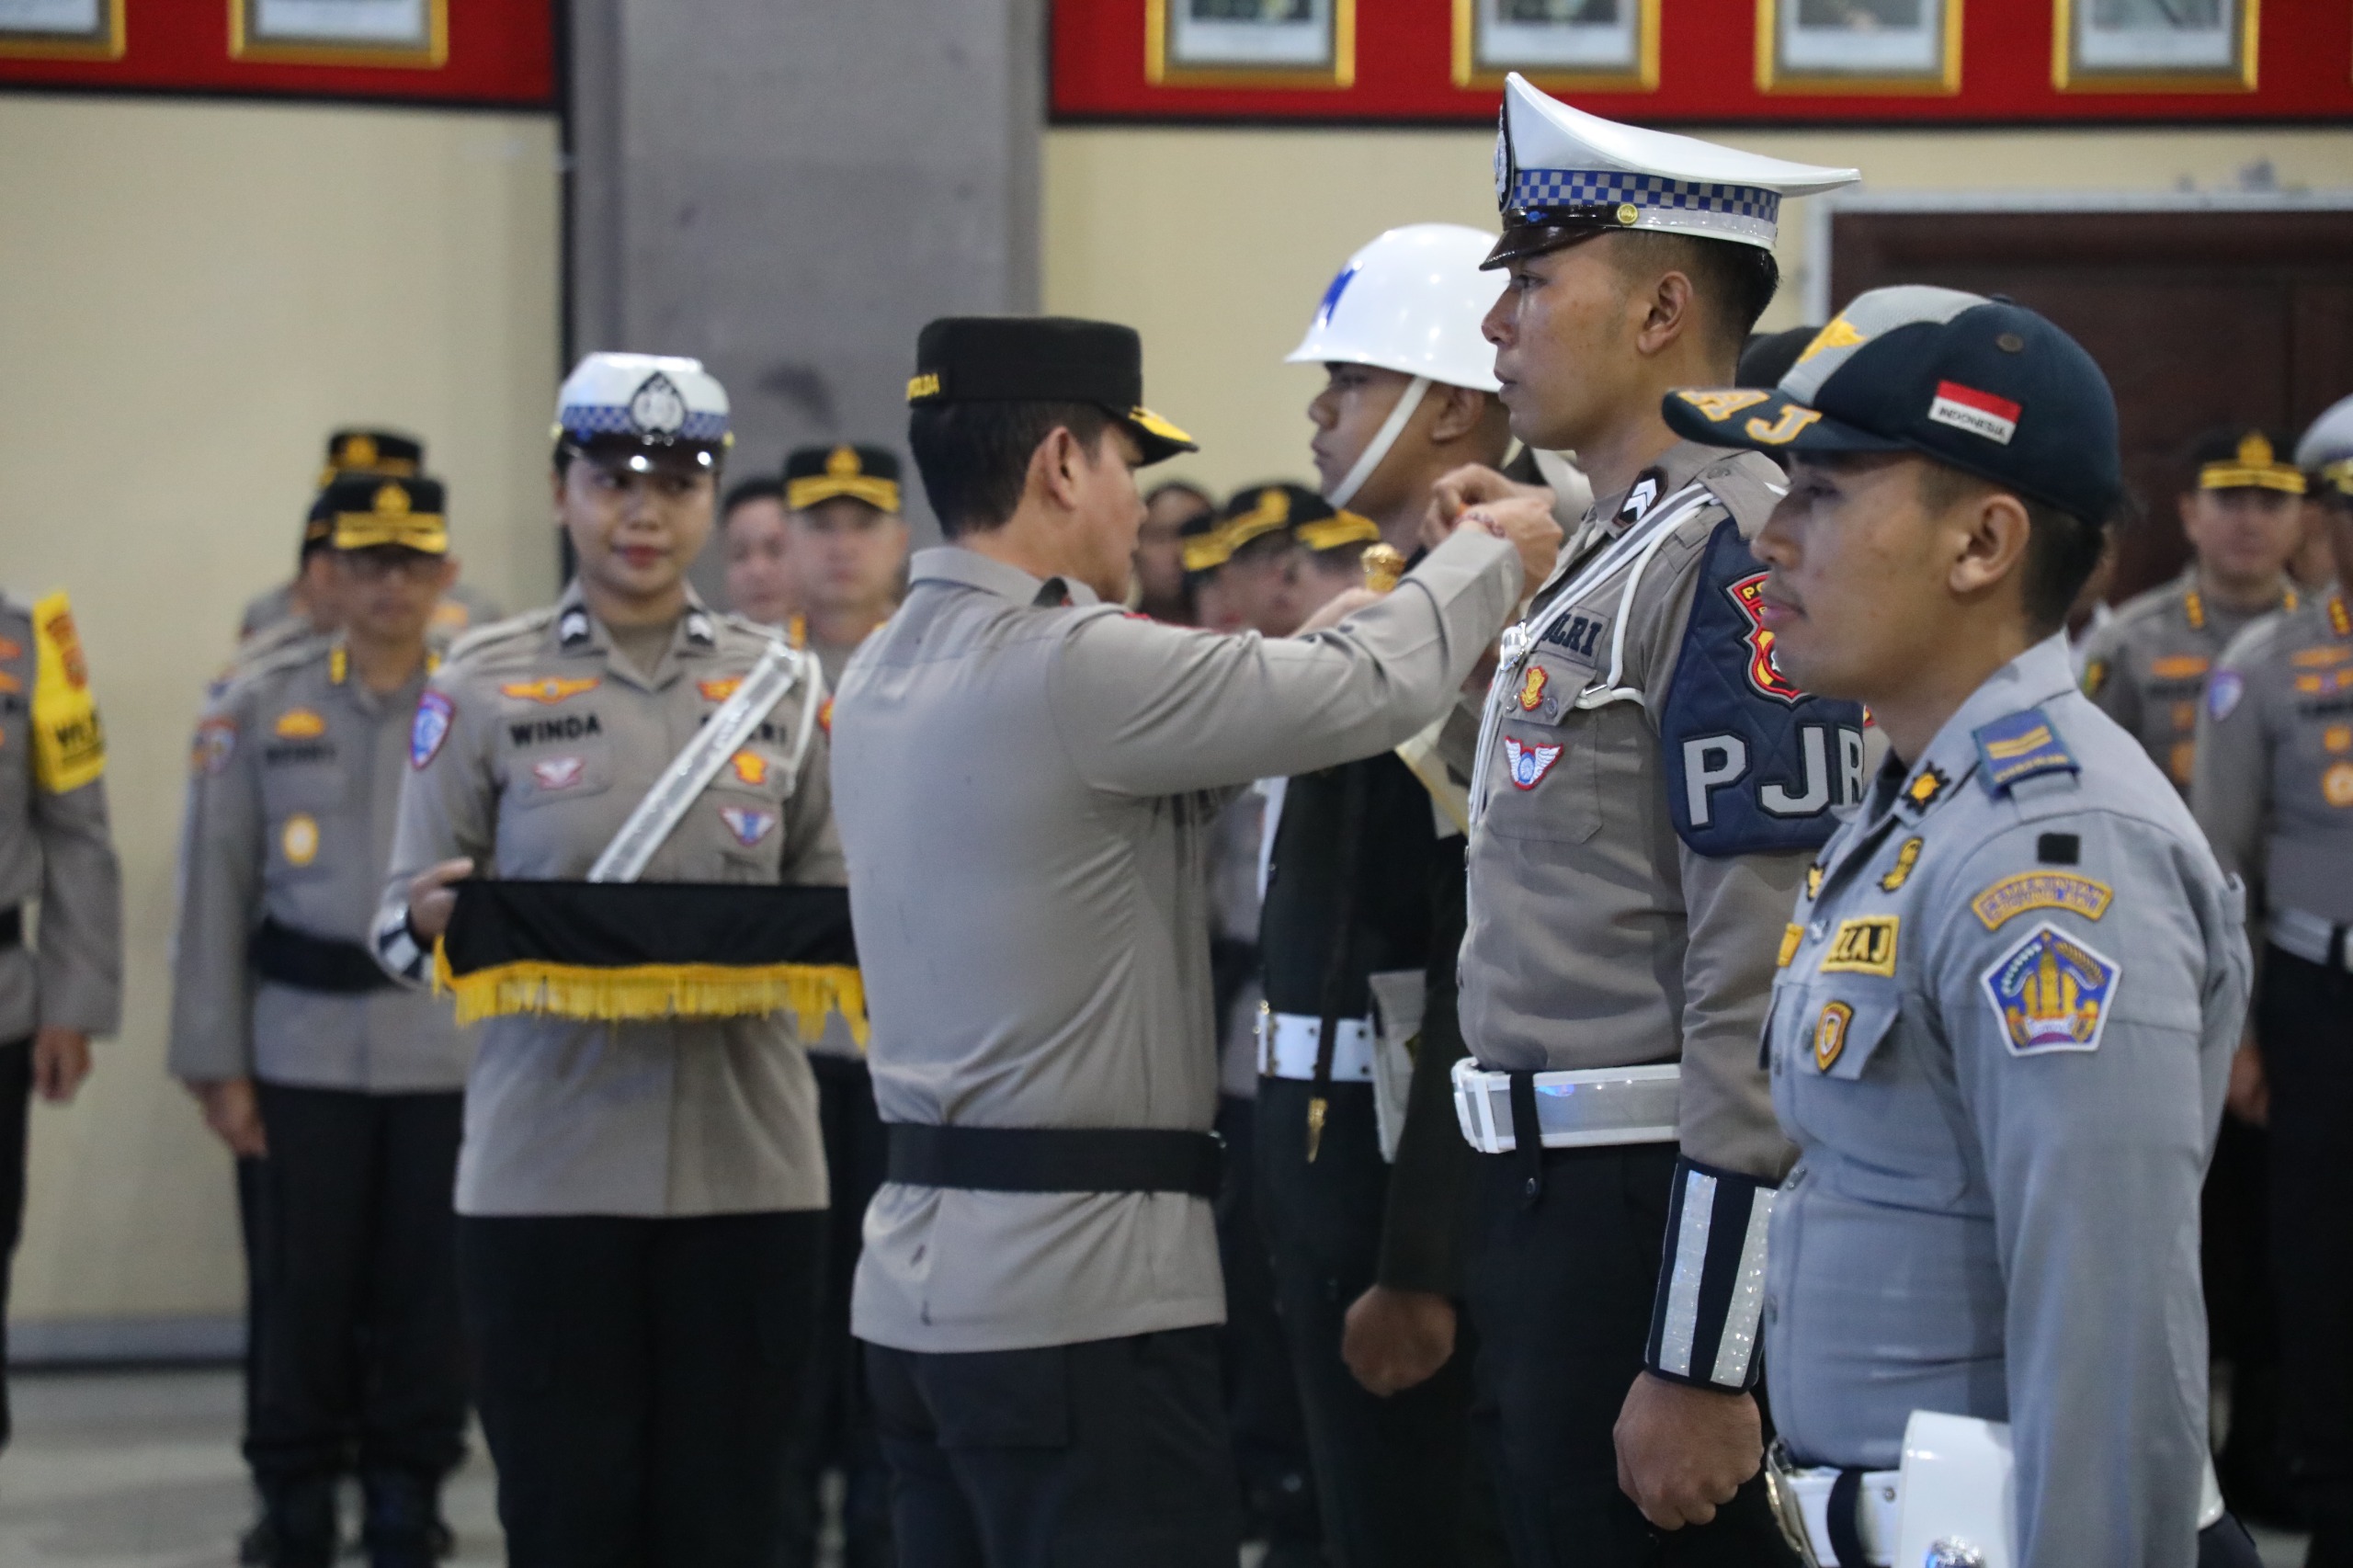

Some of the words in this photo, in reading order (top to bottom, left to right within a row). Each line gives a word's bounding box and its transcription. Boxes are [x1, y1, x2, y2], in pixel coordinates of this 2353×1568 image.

[1938, 406, 2005, 437] INDONESIA
[1541, 611, 1603, 657] LRI
[508, 713, 602, 746] WINDA
[1683, 726, 1864, 826] PJR
